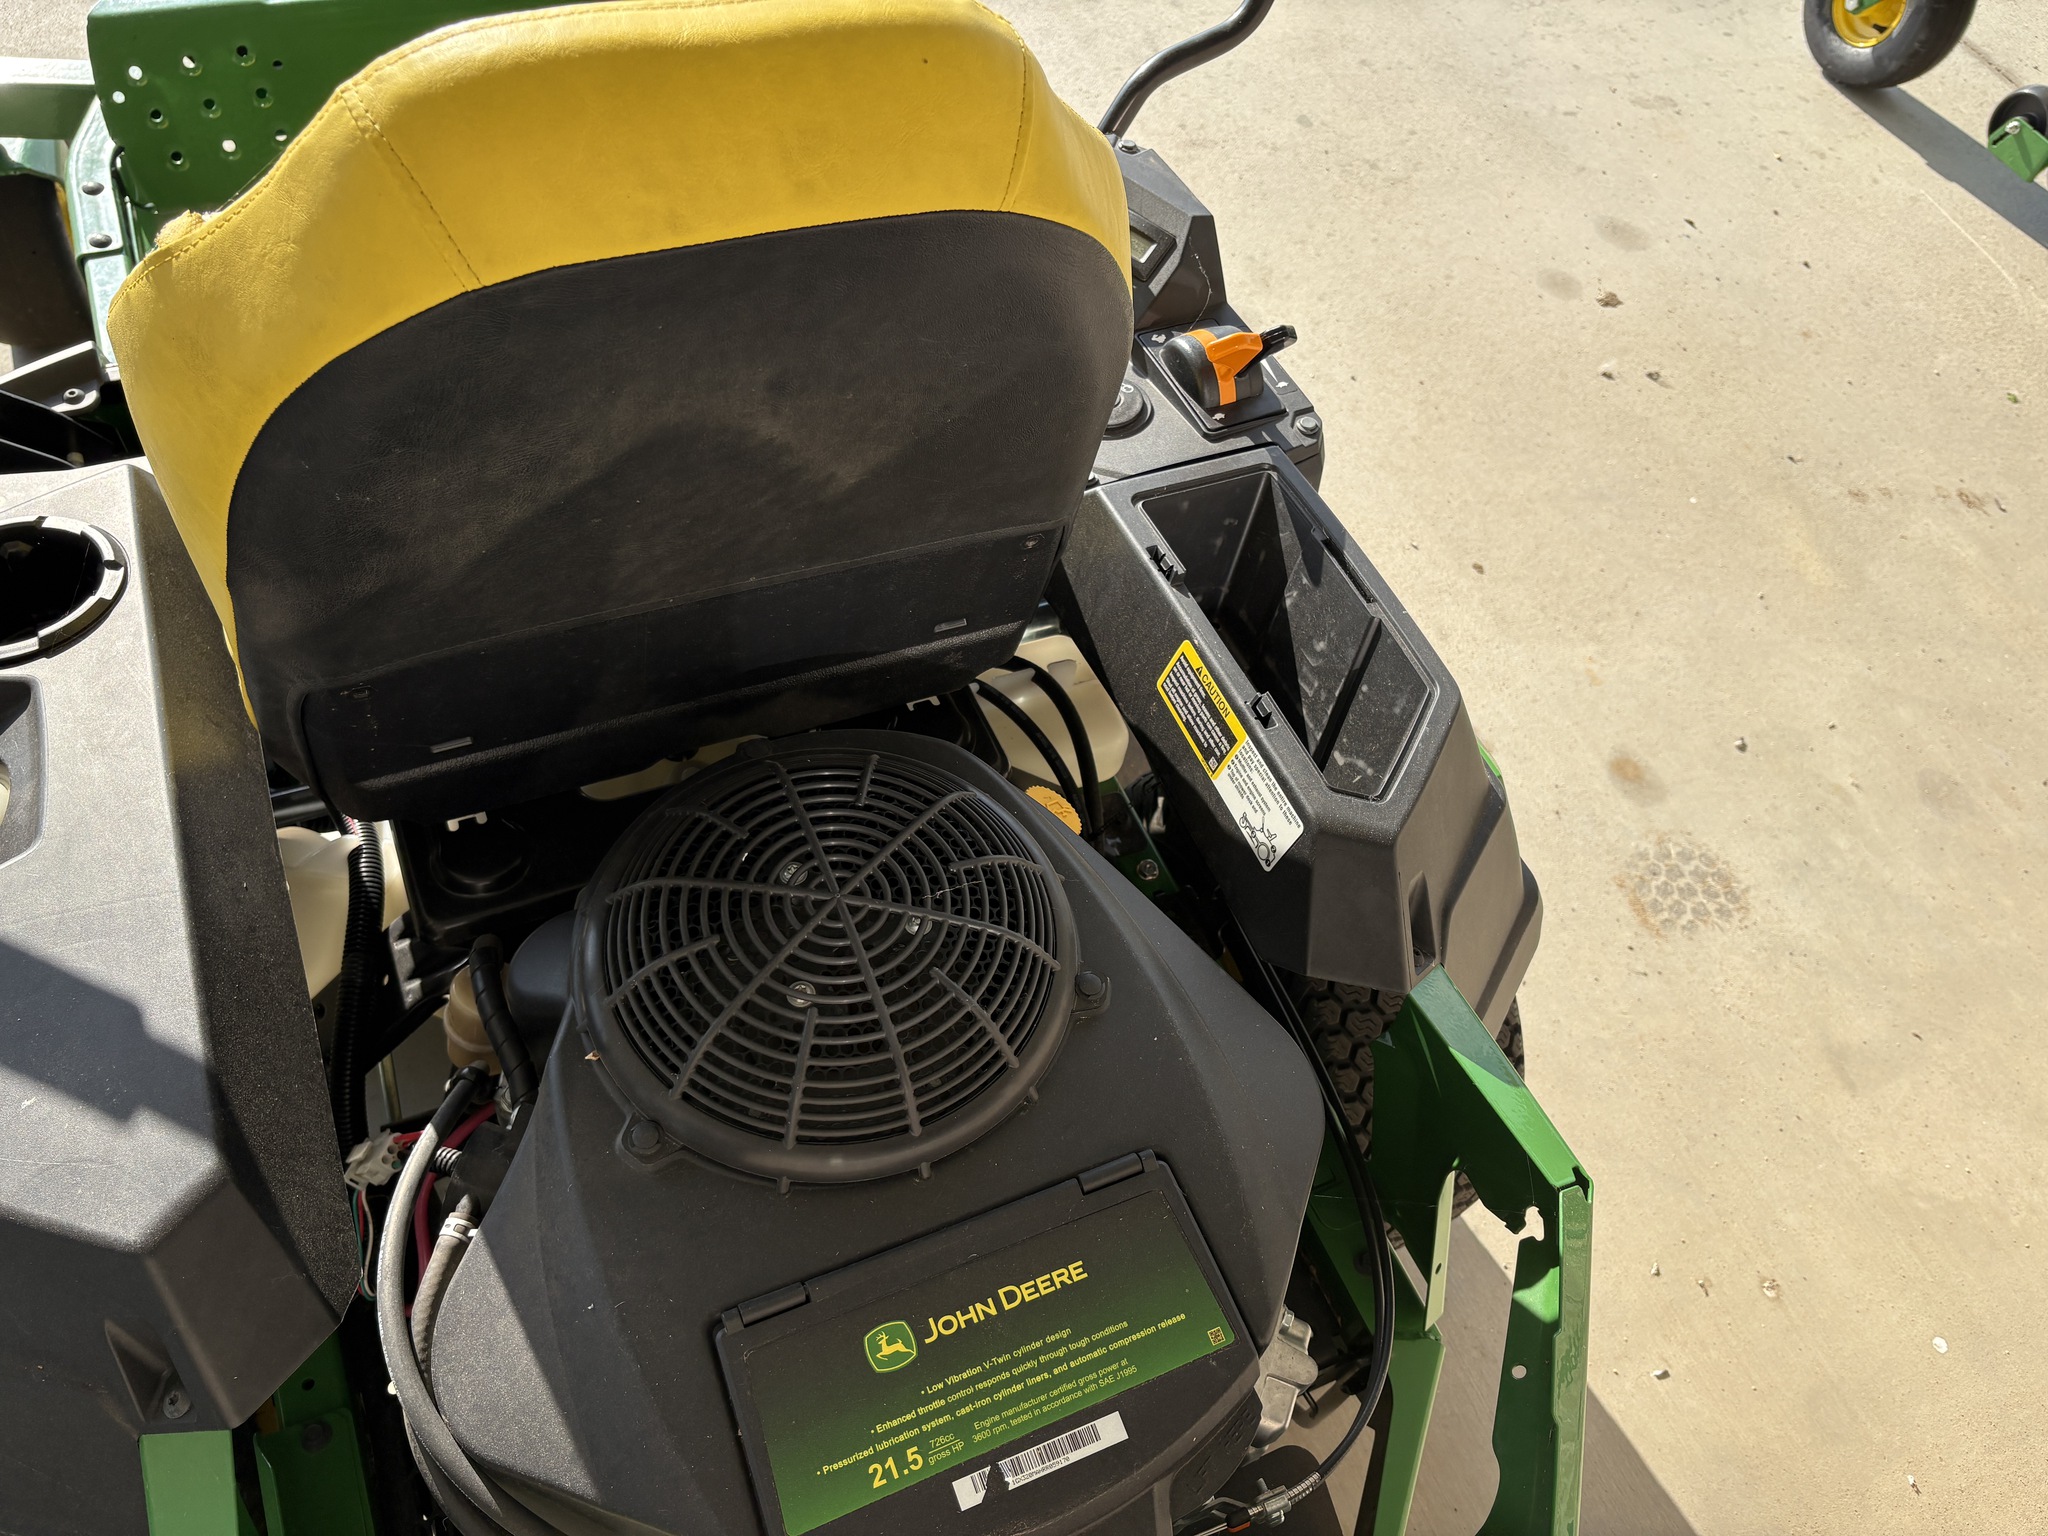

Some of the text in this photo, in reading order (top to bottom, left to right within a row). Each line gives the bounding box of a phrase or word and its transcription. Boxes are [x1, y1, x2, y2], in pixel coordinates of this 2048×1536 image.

[1180, 656, 1188, 668] Avoid
[1170, 672, 1179, 687] Inspect
[1178, 686, 1188, 704] machine
[1196, 717, 1205, 731] during
[1202, 674, 1230, 718] CAUTION
[1202, 704, 1210, 718] leaves
[1214, 726, 1222, 737] other
[1221, 736, 1230, 750] debris
[1211, 730, 1220, 742] cause
[1241, 744, 1292, 826] and pay special attention to these
[1244, 739, 1301, 828] Inspect and clean the entire machine
[925, 1261, 1088, 1344] JOHN DEERE
[876, 1321, 1128, 1433] Enhanced throttle control responds quickly through tough conditions
[926, 1328, 1071, 1394] Low Vibration V-Twin cylinder design
[823, 1314, 1185, 1474] Pressurized lubrication system, cast-iron cylinder liners, and automatic compression release
[972, 1429, 991, 1442] 3600
[993, 1424, 1009, 1434] rpm,
[1010, 1411, 1032, 1426] tested
[1042, 1391, 1082, 1412] accordance
[1083, 1383, 1098, 1394] with
[1099, 1375, 1115, 1387] SAE
[1117, 1365, 1137, 1380] J1995
[974, 1358, 1128, 1430] Engine manufacturer certified gross power at
[869, 1446, 922, 1488] 21.5
[928, 1442, 964, 1465] gross HP
[930, 1434, 954, 1448] 726cc
